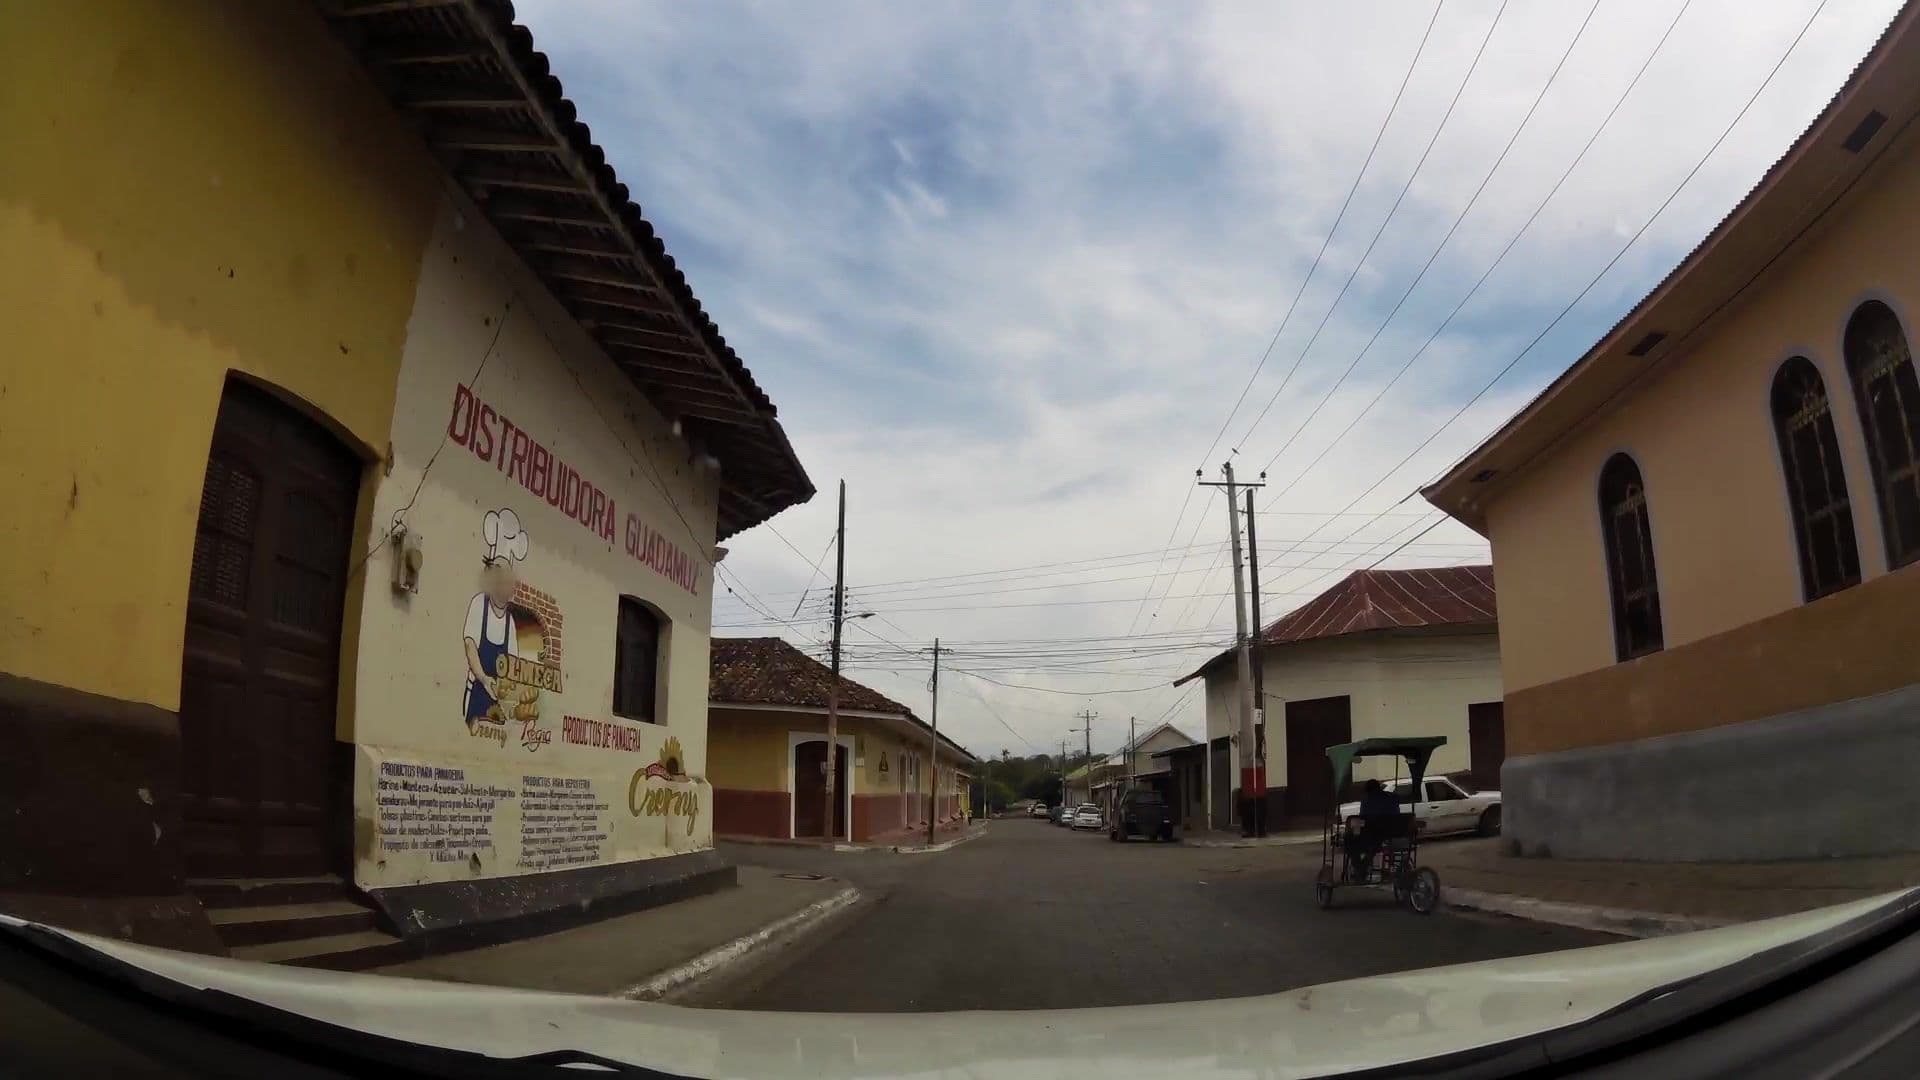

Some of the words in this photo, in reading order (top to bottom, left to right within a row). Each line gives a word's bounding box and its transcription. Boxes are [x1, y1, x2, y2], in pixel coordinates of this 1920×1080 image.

[449, 382, 616, 544] DISTRIBUIDORA
[496, 653, 562, 693] OLMECA
[519, 719, 551, 752] Regia
[562, 715, 602, 748] PRODUCTOS
[602, 723, 611, 748] DE
[381, 762, 416, 777] PRODUCTOS
[416, 765, 432, 778] PARA
[523, 775, 551, 788] PRODUCTOS
[628, 768, 698, 836] Cremy
